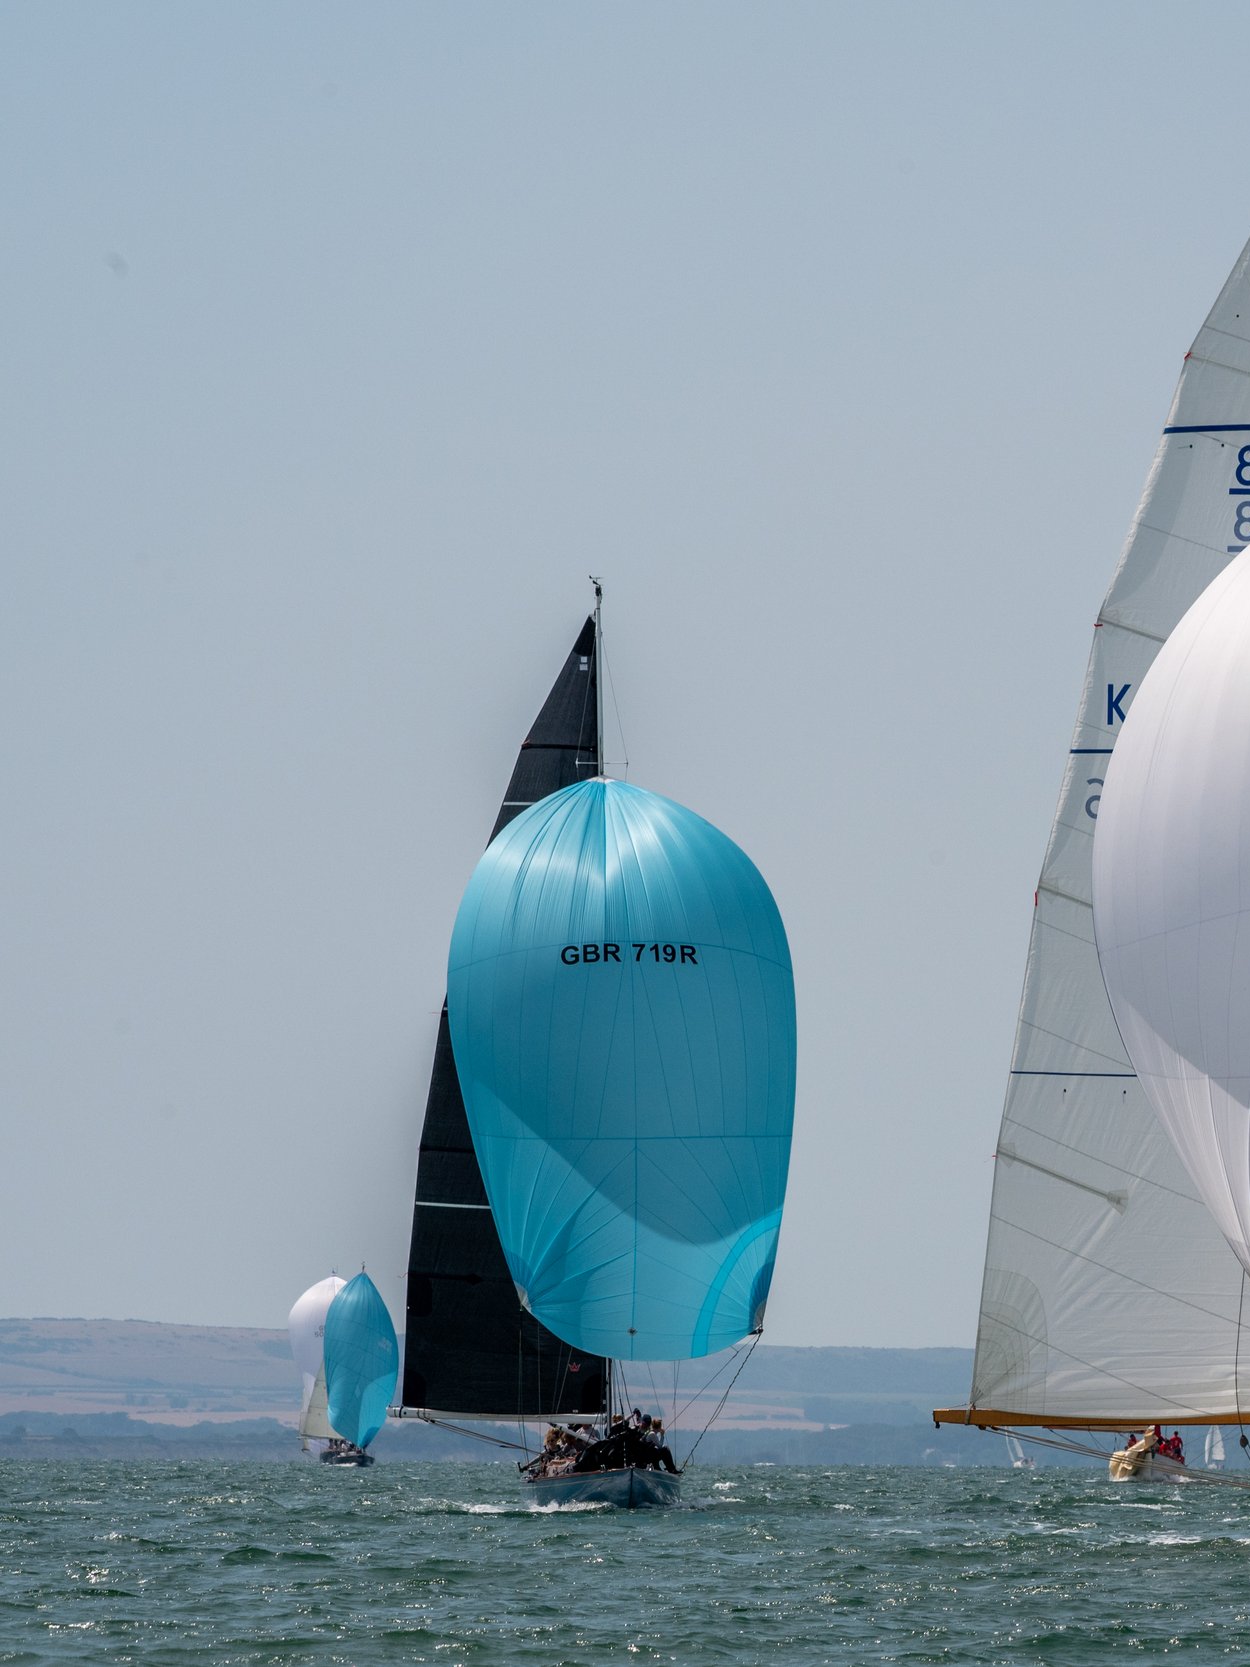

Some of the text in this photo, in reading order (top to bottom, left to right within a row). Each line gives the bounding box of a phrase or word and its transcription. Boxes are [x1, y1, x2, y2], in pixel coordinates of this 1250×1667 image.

[1107, 684, 1131, 725] K
[561, 943, 698, 965] GBR 719R
